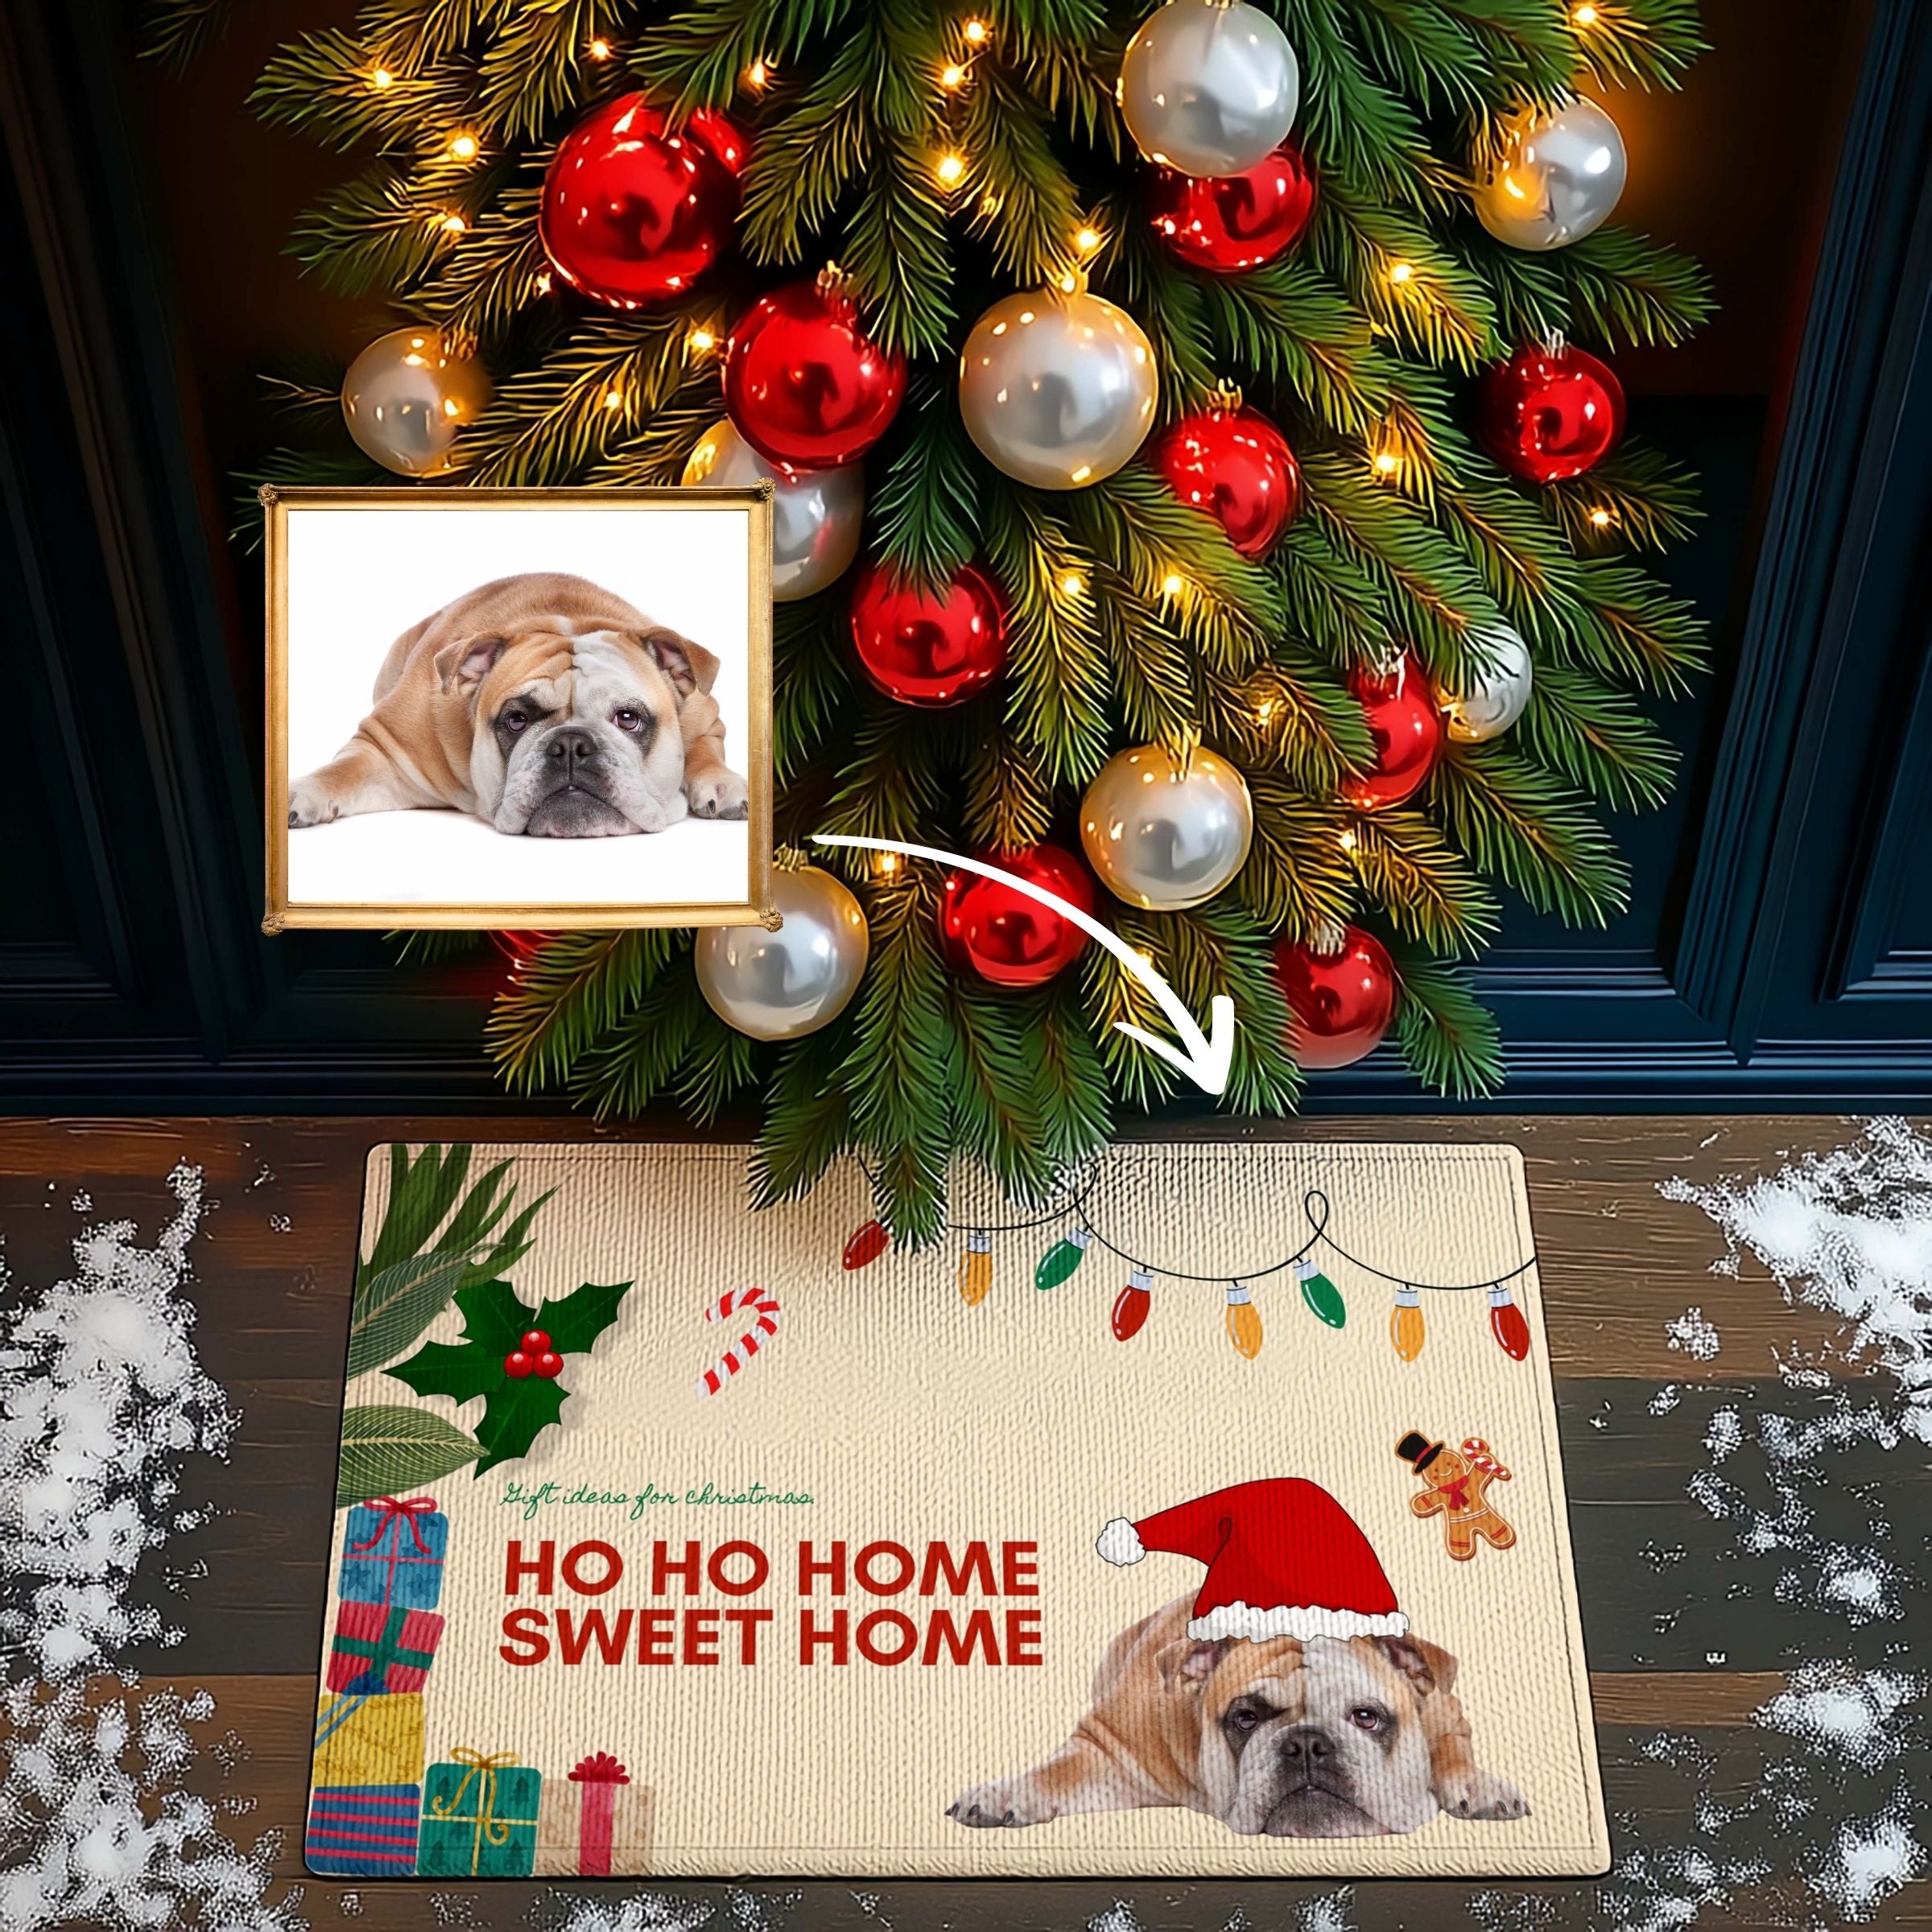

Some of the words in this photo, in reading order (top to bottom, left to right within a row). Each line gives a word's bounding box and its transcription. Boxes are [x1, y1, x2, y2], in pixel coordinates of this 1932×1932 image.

[500, 1482, 563, 1521] Gift
[563, 1484, 631, 1505] ideas
[630, 1483, 679, 1521] for
[506, 1540, 623, 1596] HO
[652, 1540, 770, 1596] HO
[799, 1541, 1038, 1596] HOME
[499, 1608, 773, 1666] SWEET
[800, 1608, 1043, 1666] HOME
